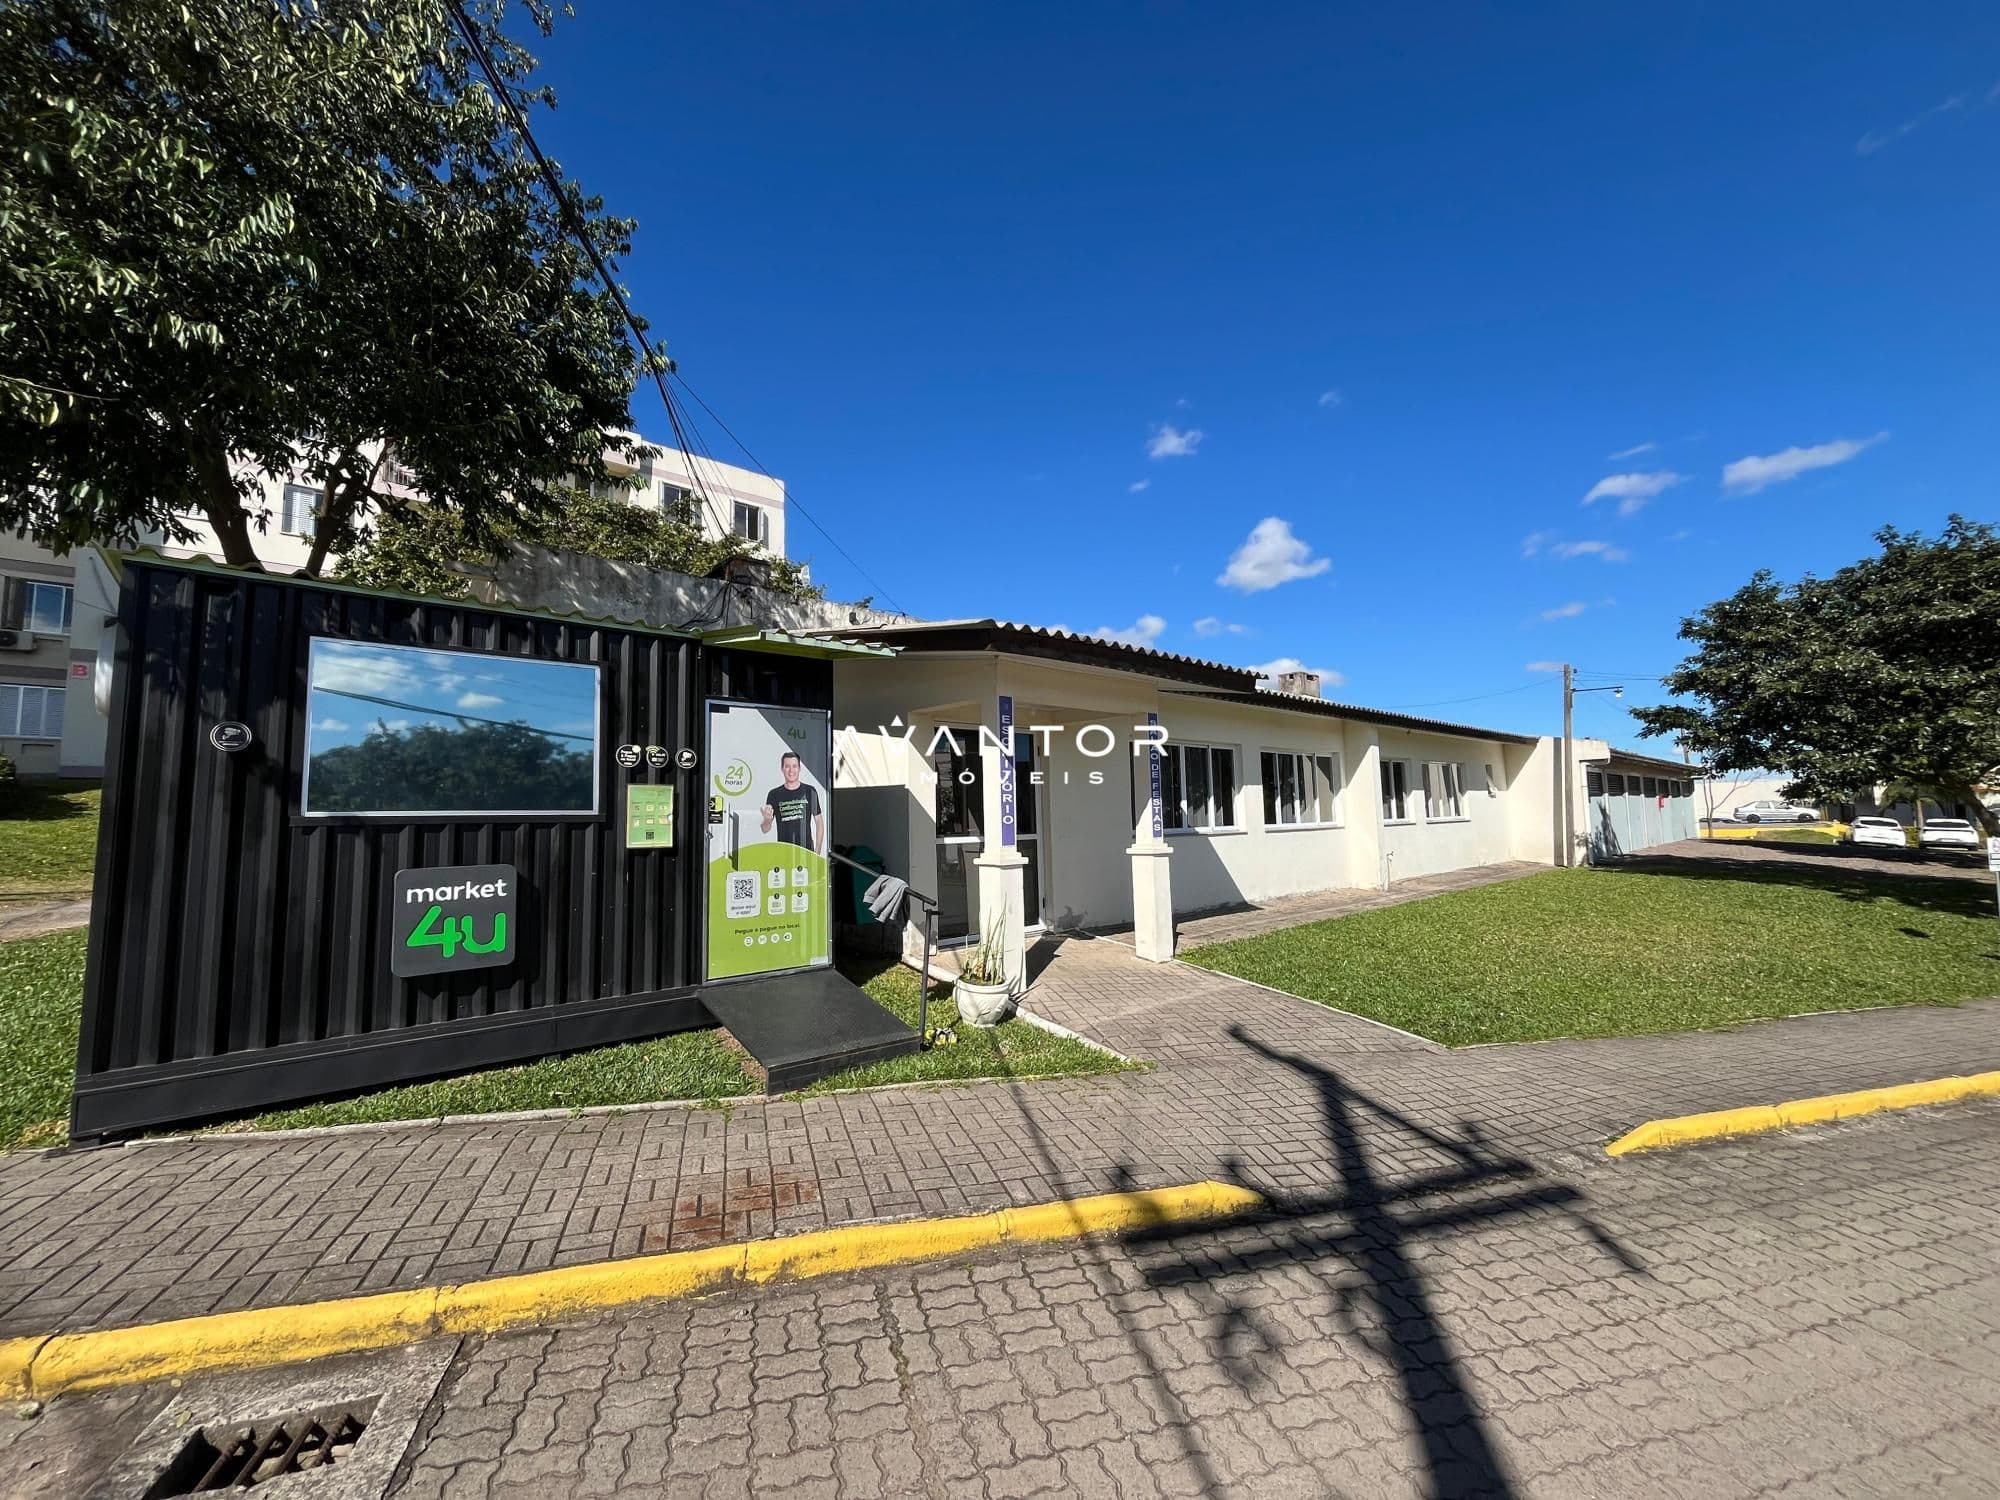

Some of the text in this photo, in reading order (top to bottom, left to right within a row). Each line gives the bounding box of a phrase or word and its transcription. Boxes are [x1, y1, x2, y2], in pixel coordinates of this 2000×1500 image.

[725, 765, 744, 780] 24
[1151, 763, 1159, 778] DE
[1152, 782, 1161, 831] FESTAS
[406, 879, 507, 904] market
